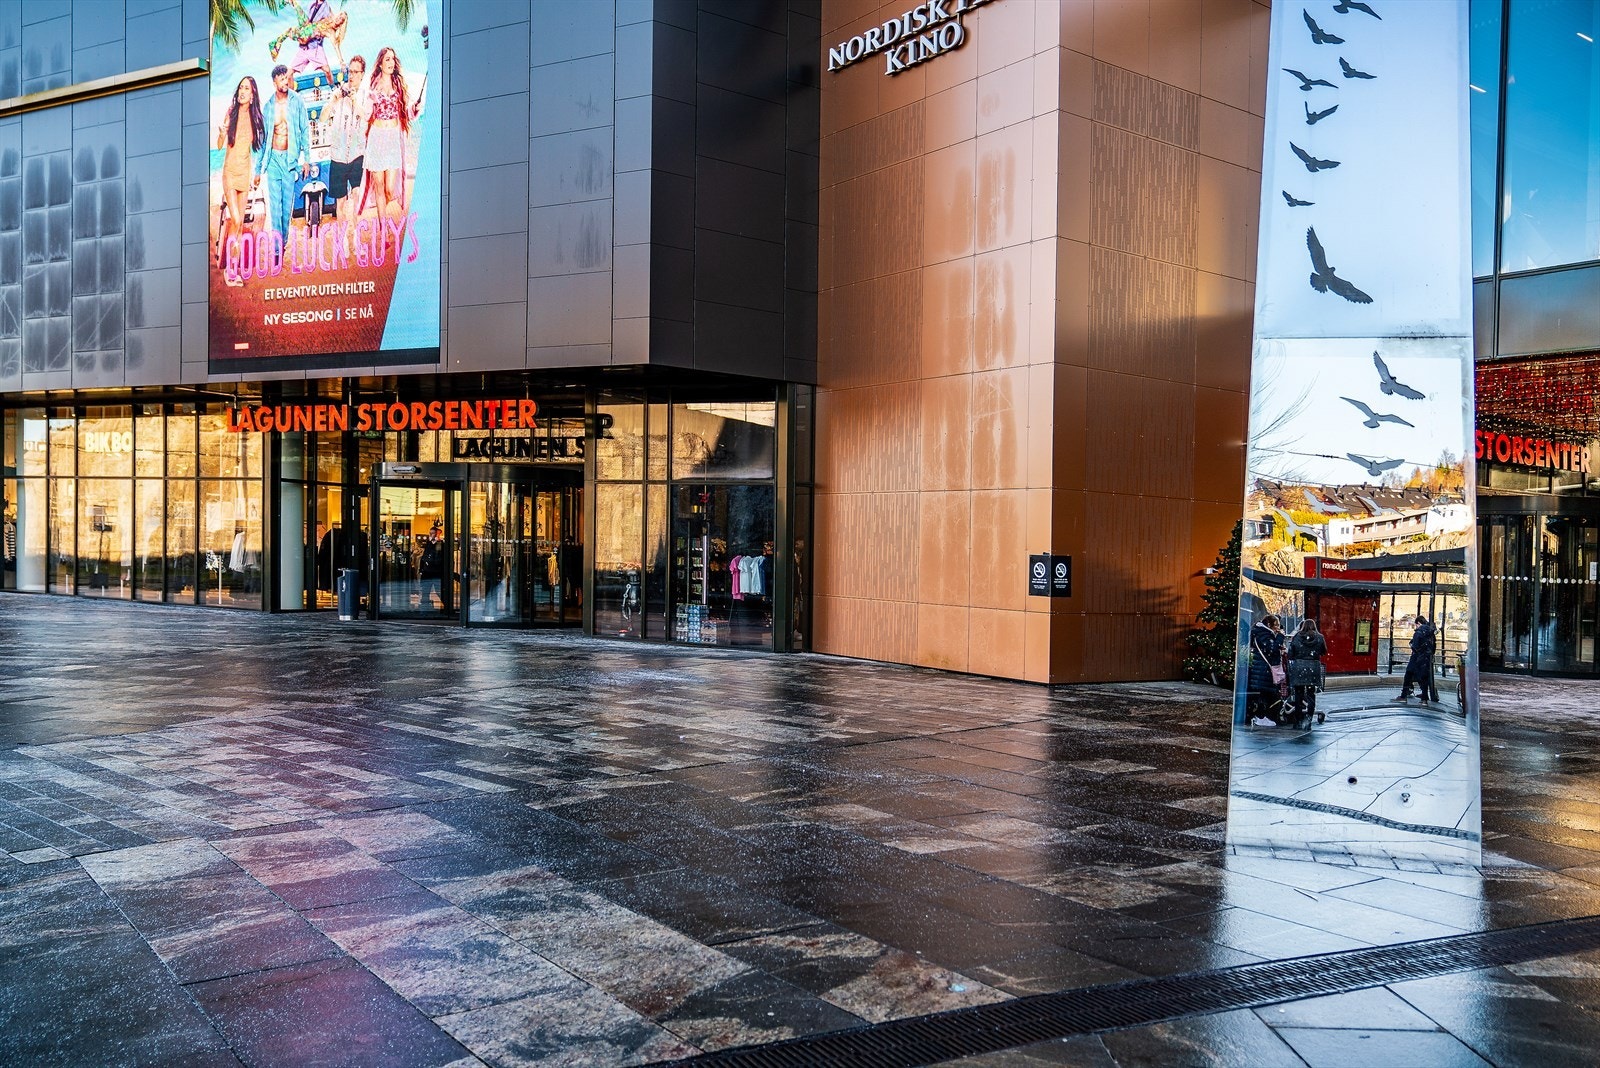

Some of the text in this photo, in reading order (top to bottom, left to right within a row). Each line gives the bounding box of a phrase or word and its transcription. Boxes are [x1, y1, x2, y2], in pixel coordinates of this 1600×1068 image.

[827, 0, 949, 71] NORDISK
[885, 22, 964, 75] KINO
[226, 212, 420, 280] GOOD LUCK GUYS
[264, 281, 375, 300] ET EVENTYR UTEN FILTER
[264, 304, 375, 325] NY SESONG SE NÅ
[226, 399, 537, 433] LAGUNEN STORSENTER
[1475, 429, 1592, 473] STORSENTER
